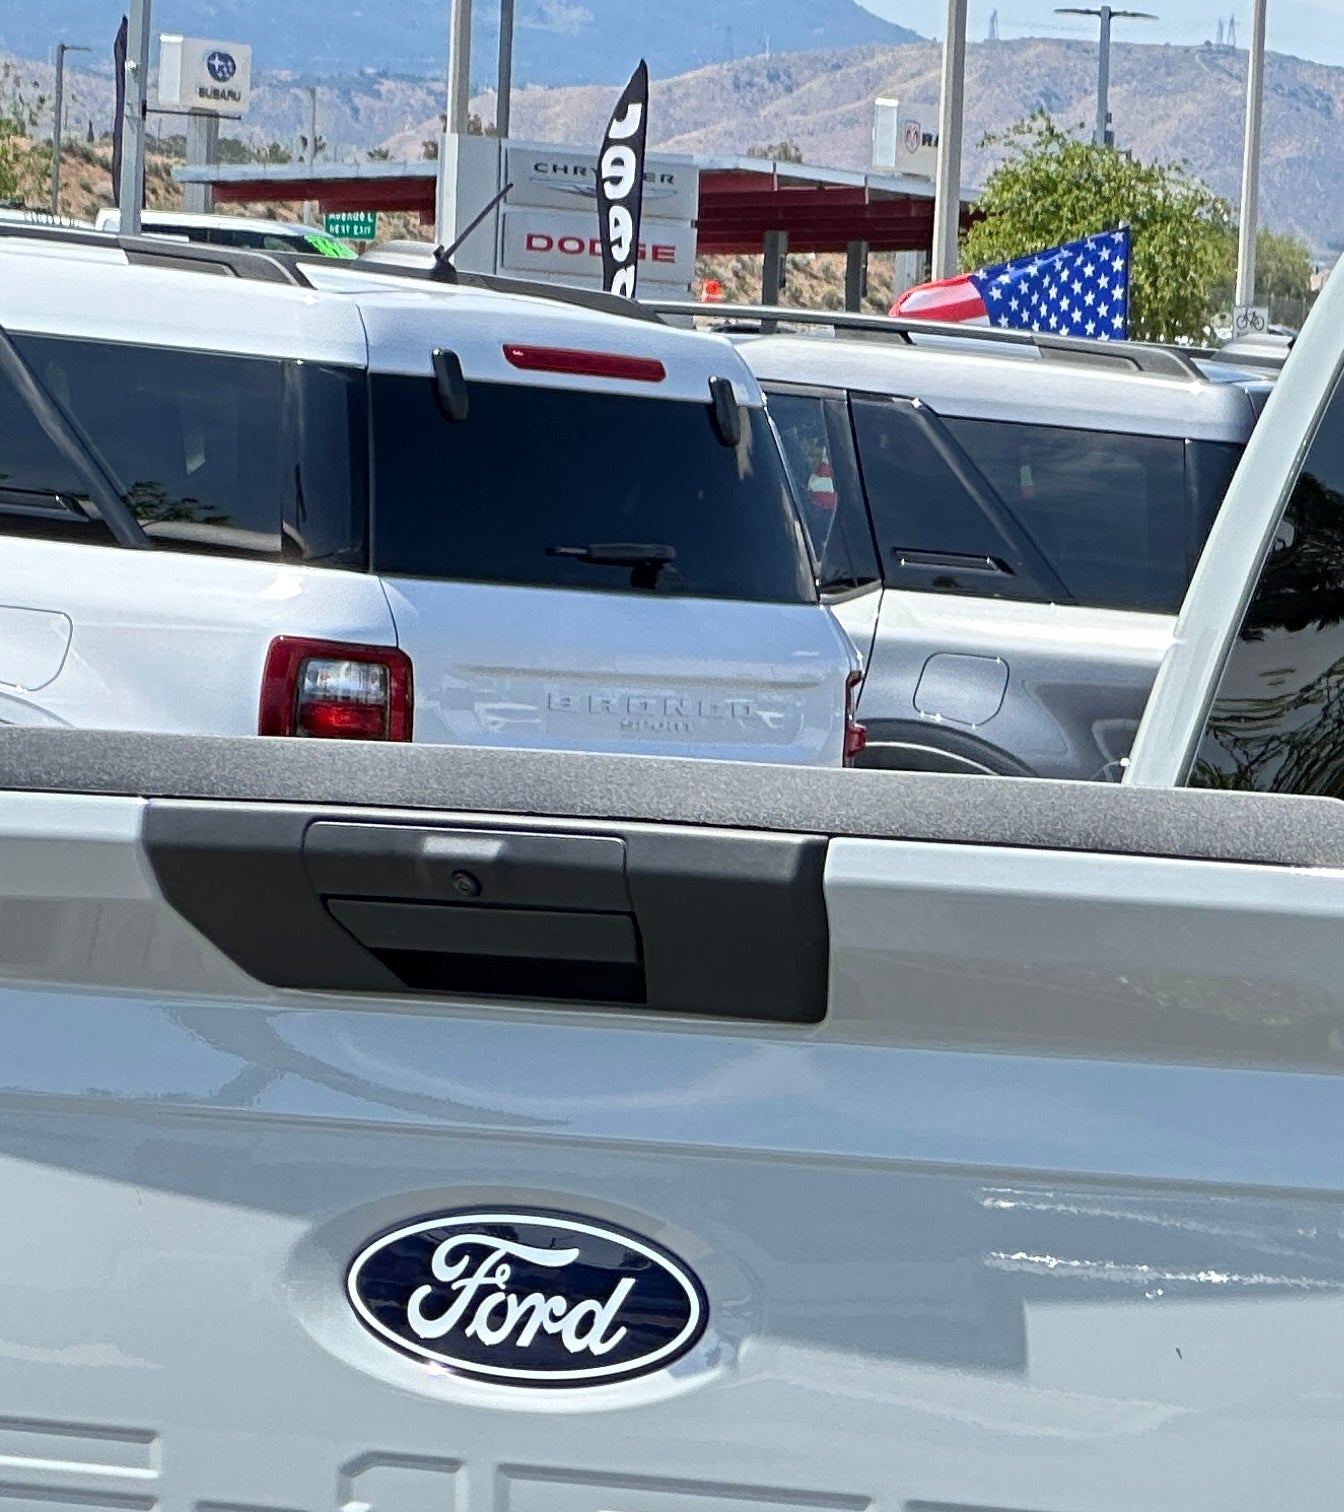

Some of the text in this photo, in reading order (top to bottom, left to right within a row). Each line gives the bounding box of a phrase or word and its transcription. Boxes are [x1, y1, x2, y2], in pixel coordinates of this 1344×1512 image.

[533, 162, 674, 185] CHRER
[526, 233, 676, 263] DOE
[407, 1233, 637, 1356] Ford
